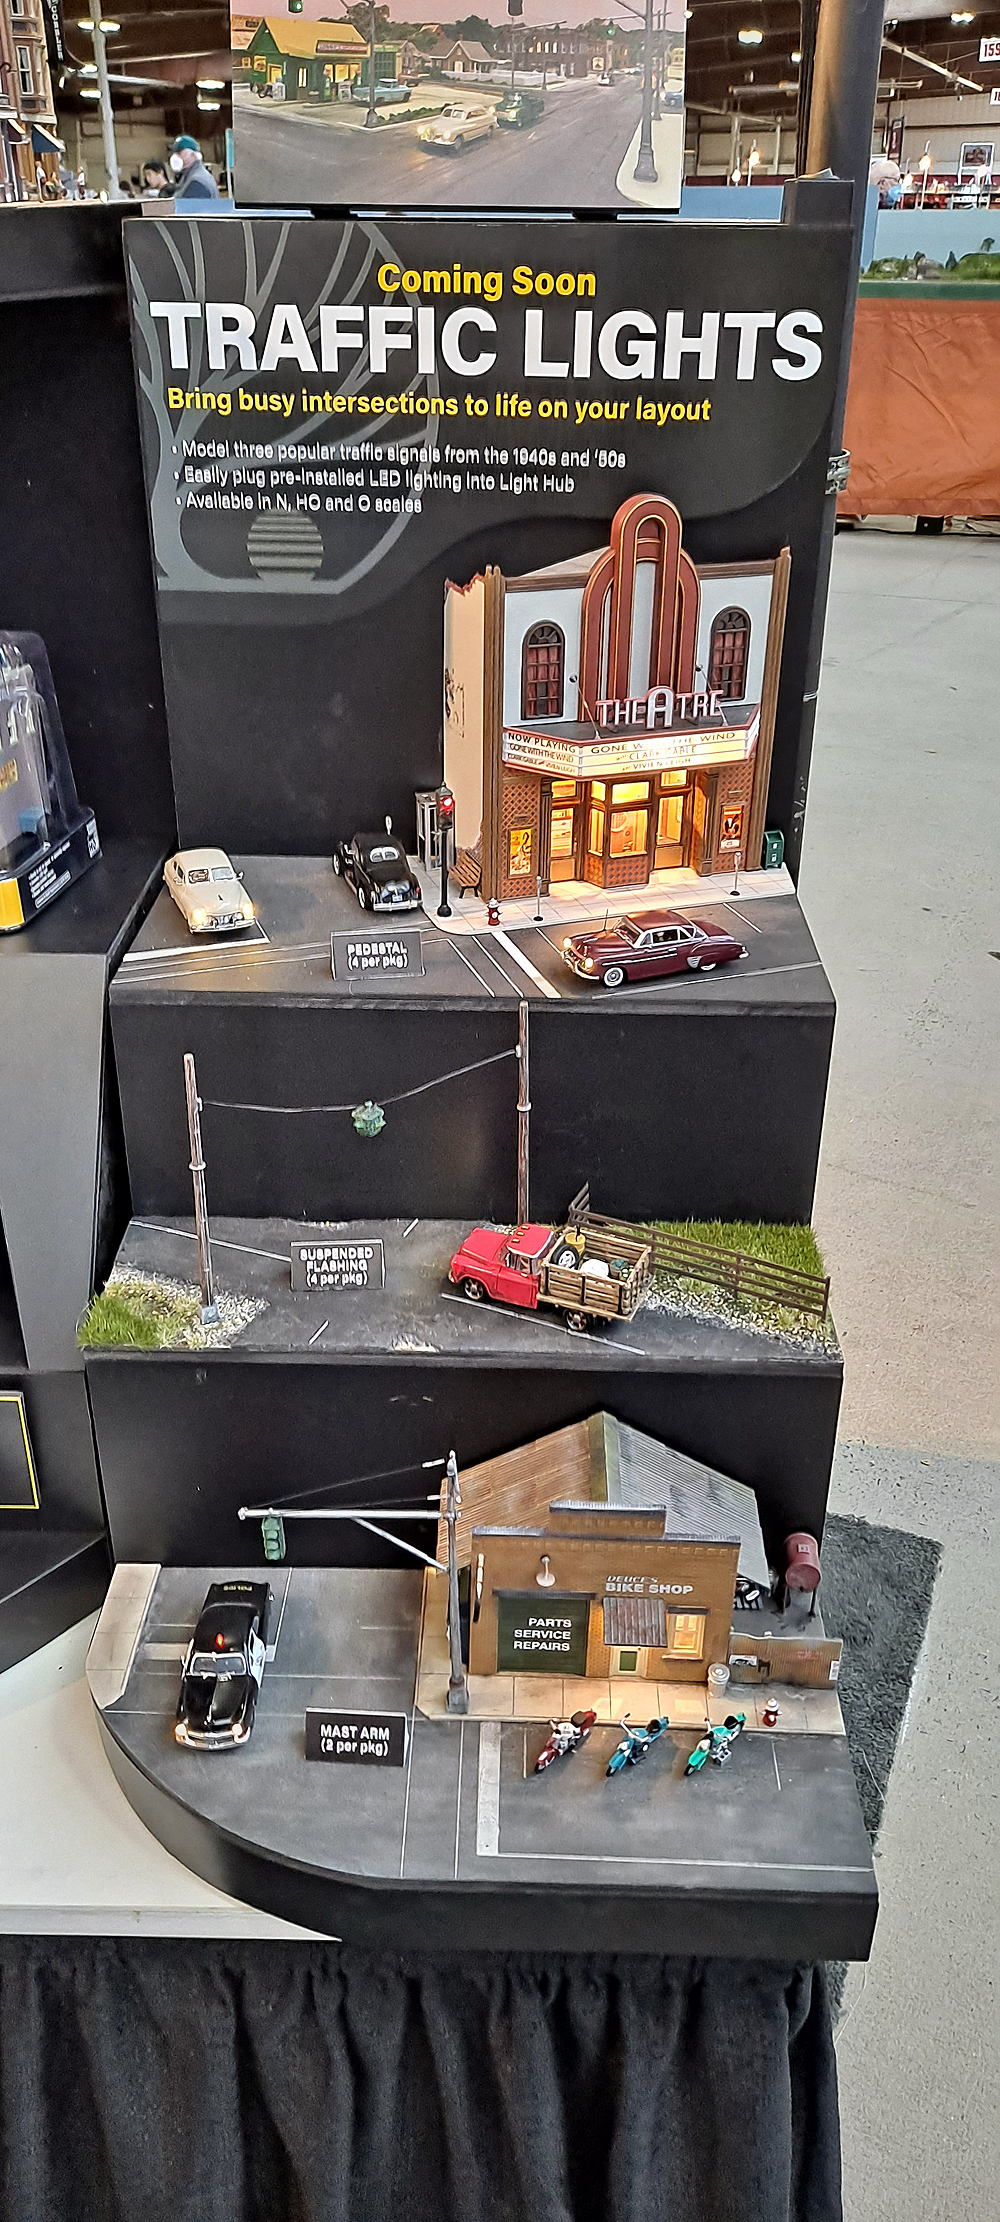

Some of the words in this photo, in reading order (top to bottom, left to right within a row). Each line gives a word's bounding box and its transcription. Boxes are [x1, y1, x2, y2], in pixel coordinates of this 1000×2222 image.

[377, 263, 504, 300] Coming
[512, 265, 597, 297] Soon
[150, 301, 498, 377] TRAFFIC
[525, 308, 822, 381] LIGHTS
[168, 387, 232, 416] Bring
[238, 389, 296, 419] busy
[301, 390, 458, 418] intersections
[465, 394, 488, 417] to
[495, 393, 532, 419] life
[538, 400, 568, 420] on
[575, 400, 629, 425] your
[635, 395, 711, 425] layout
[182, 440, 230, 458] Model
[234, 441, 273, 460] three
[278, 442, 336, 462] popular
[340, 442, 383, 461] traffic
[387, 444, 440, 466] signals
[445, 444, 480, 464] from
[485, 446, 509, 465] the
[513, 448, 557, 467] 1940s
[561, 448, 590, 468] and
[184, 466, 228, 487] Easily
[232, 467, 265, 488] plug
[270, 468, 365, 489] pre-installed
[370, 470, 400, 488] LED
[405, 470, 462, 493] lighting
[466, 471, 495, 491] into
[500, 472, 539, 495] Light
[543, 474, 575, 493] Hub
[186, 491, 254, 511] Available
[257, 493, 272, 510] in
[276, 493, 292, 513] N,
[296, 493, 321, 512] HO
[325, 494, 354, 512] and
[358, 494, 371, 512] O
[375, 495, 422, 514] scales
[595, 685, 724, 730] THEATRE
[508, 732, 531, 744] NOW
[534, 737, 576, 754] PLAYING
[590, 743, 628, 754] GONE
[700, 731, 736, 743] WIND
[555, 751, 574, 764] WIND
[632, 761, 663, 770] VIVIEN
[347, 941, 408, 956] PEDESTAL
[347, 954, 359, 971] (4
[361, 956, 380, 970] per
[382, 954, 408, 970] pkg)
[300, 1246, 374, 1260] SUSPENDED
[306, 1259, 368, 1273] FLASHING
[306, 1271, 318, 1287] (4
[320, 1273, 340, 1287] per
[341, 1271, 368, 1286] pkg)
[605, 1583, 643, 1594] BIKE
[649, 1584, 694, 1595] SHOP
[528, 1617, 572, 1628] PARTS
[514, 1628, 571, 1640] SERVICE
[513, 1640, 570, 1652] REPAIRS
[320, 1724, 358, 1739] MAST
[360, 1726, 390, 1740] ARM
[320, 1738, 334, 1753] (2
[336, 1740, 357, 1754] per
[360, 1740, 388, 1756] pkg)
